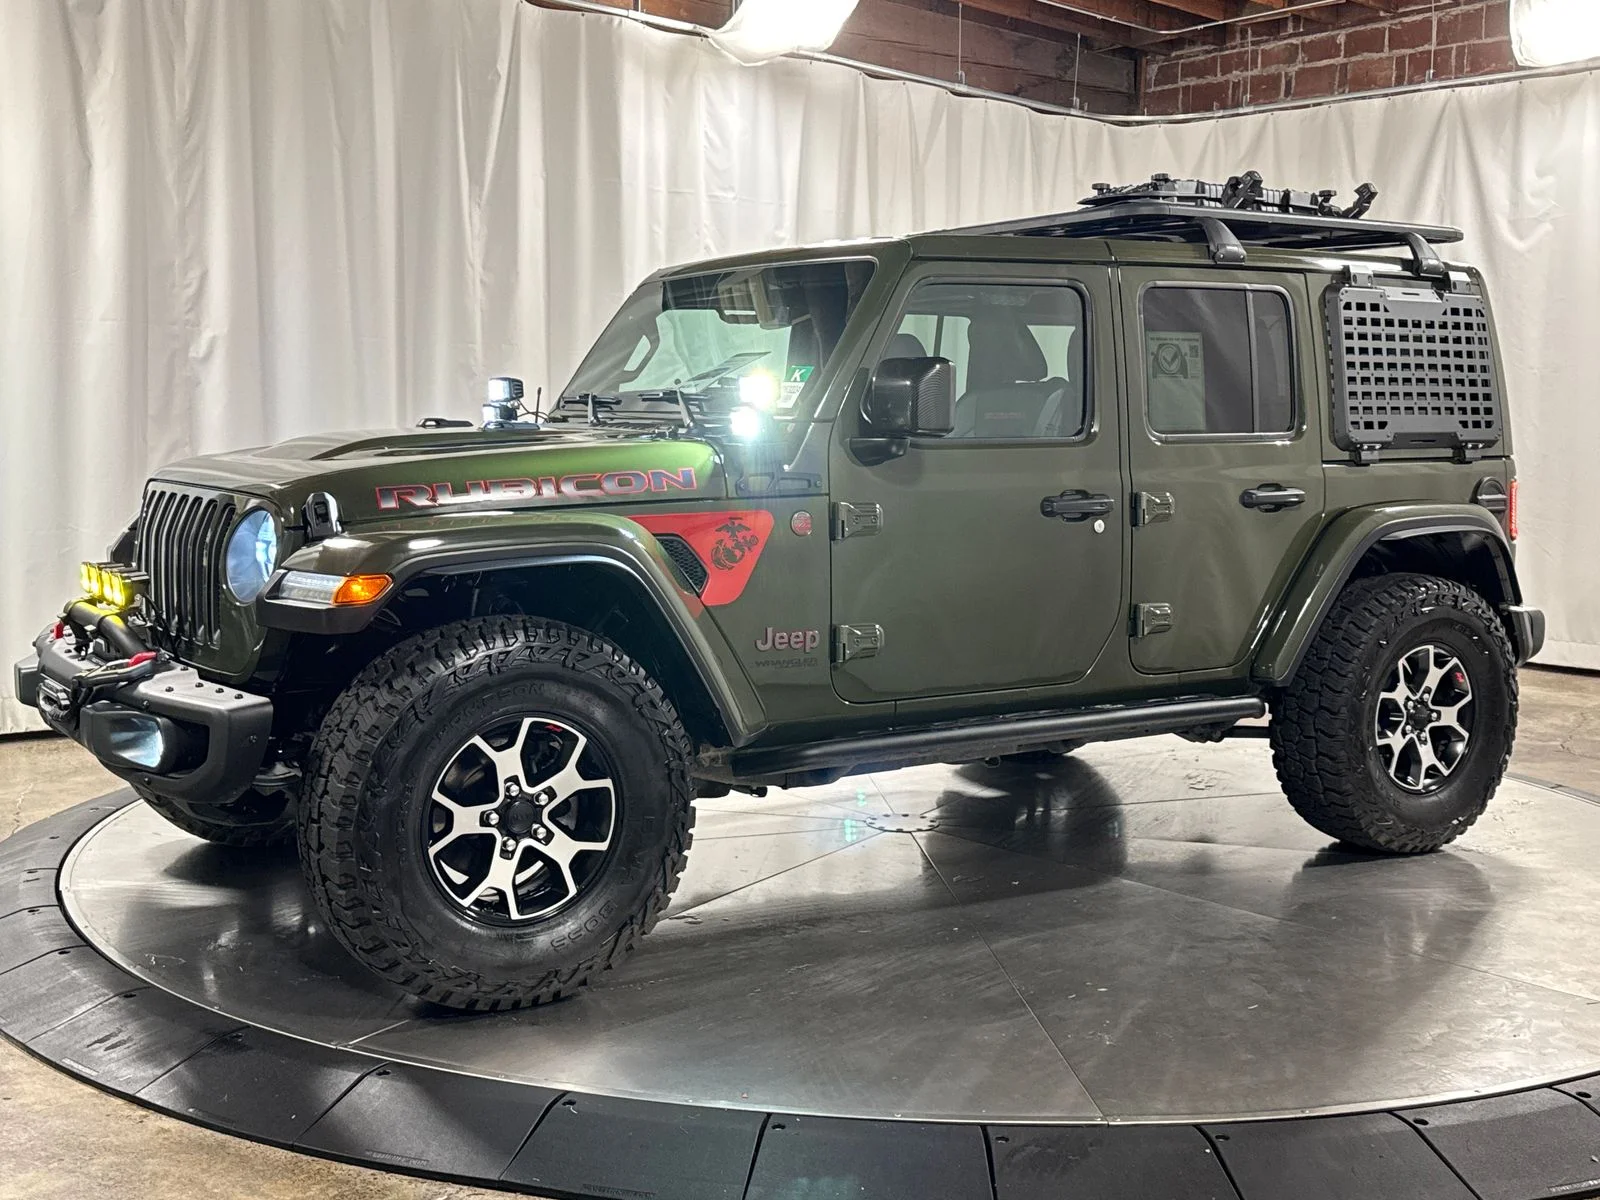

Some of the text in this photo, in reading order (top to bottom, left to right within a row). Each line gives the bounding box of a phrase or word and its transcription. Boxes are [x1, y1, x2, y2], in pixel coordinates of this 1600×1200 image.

[791, 368, 806, 382] K
[375, 468, 697, 510] RUBICON
[755, 626, 820, 654] Jeep
